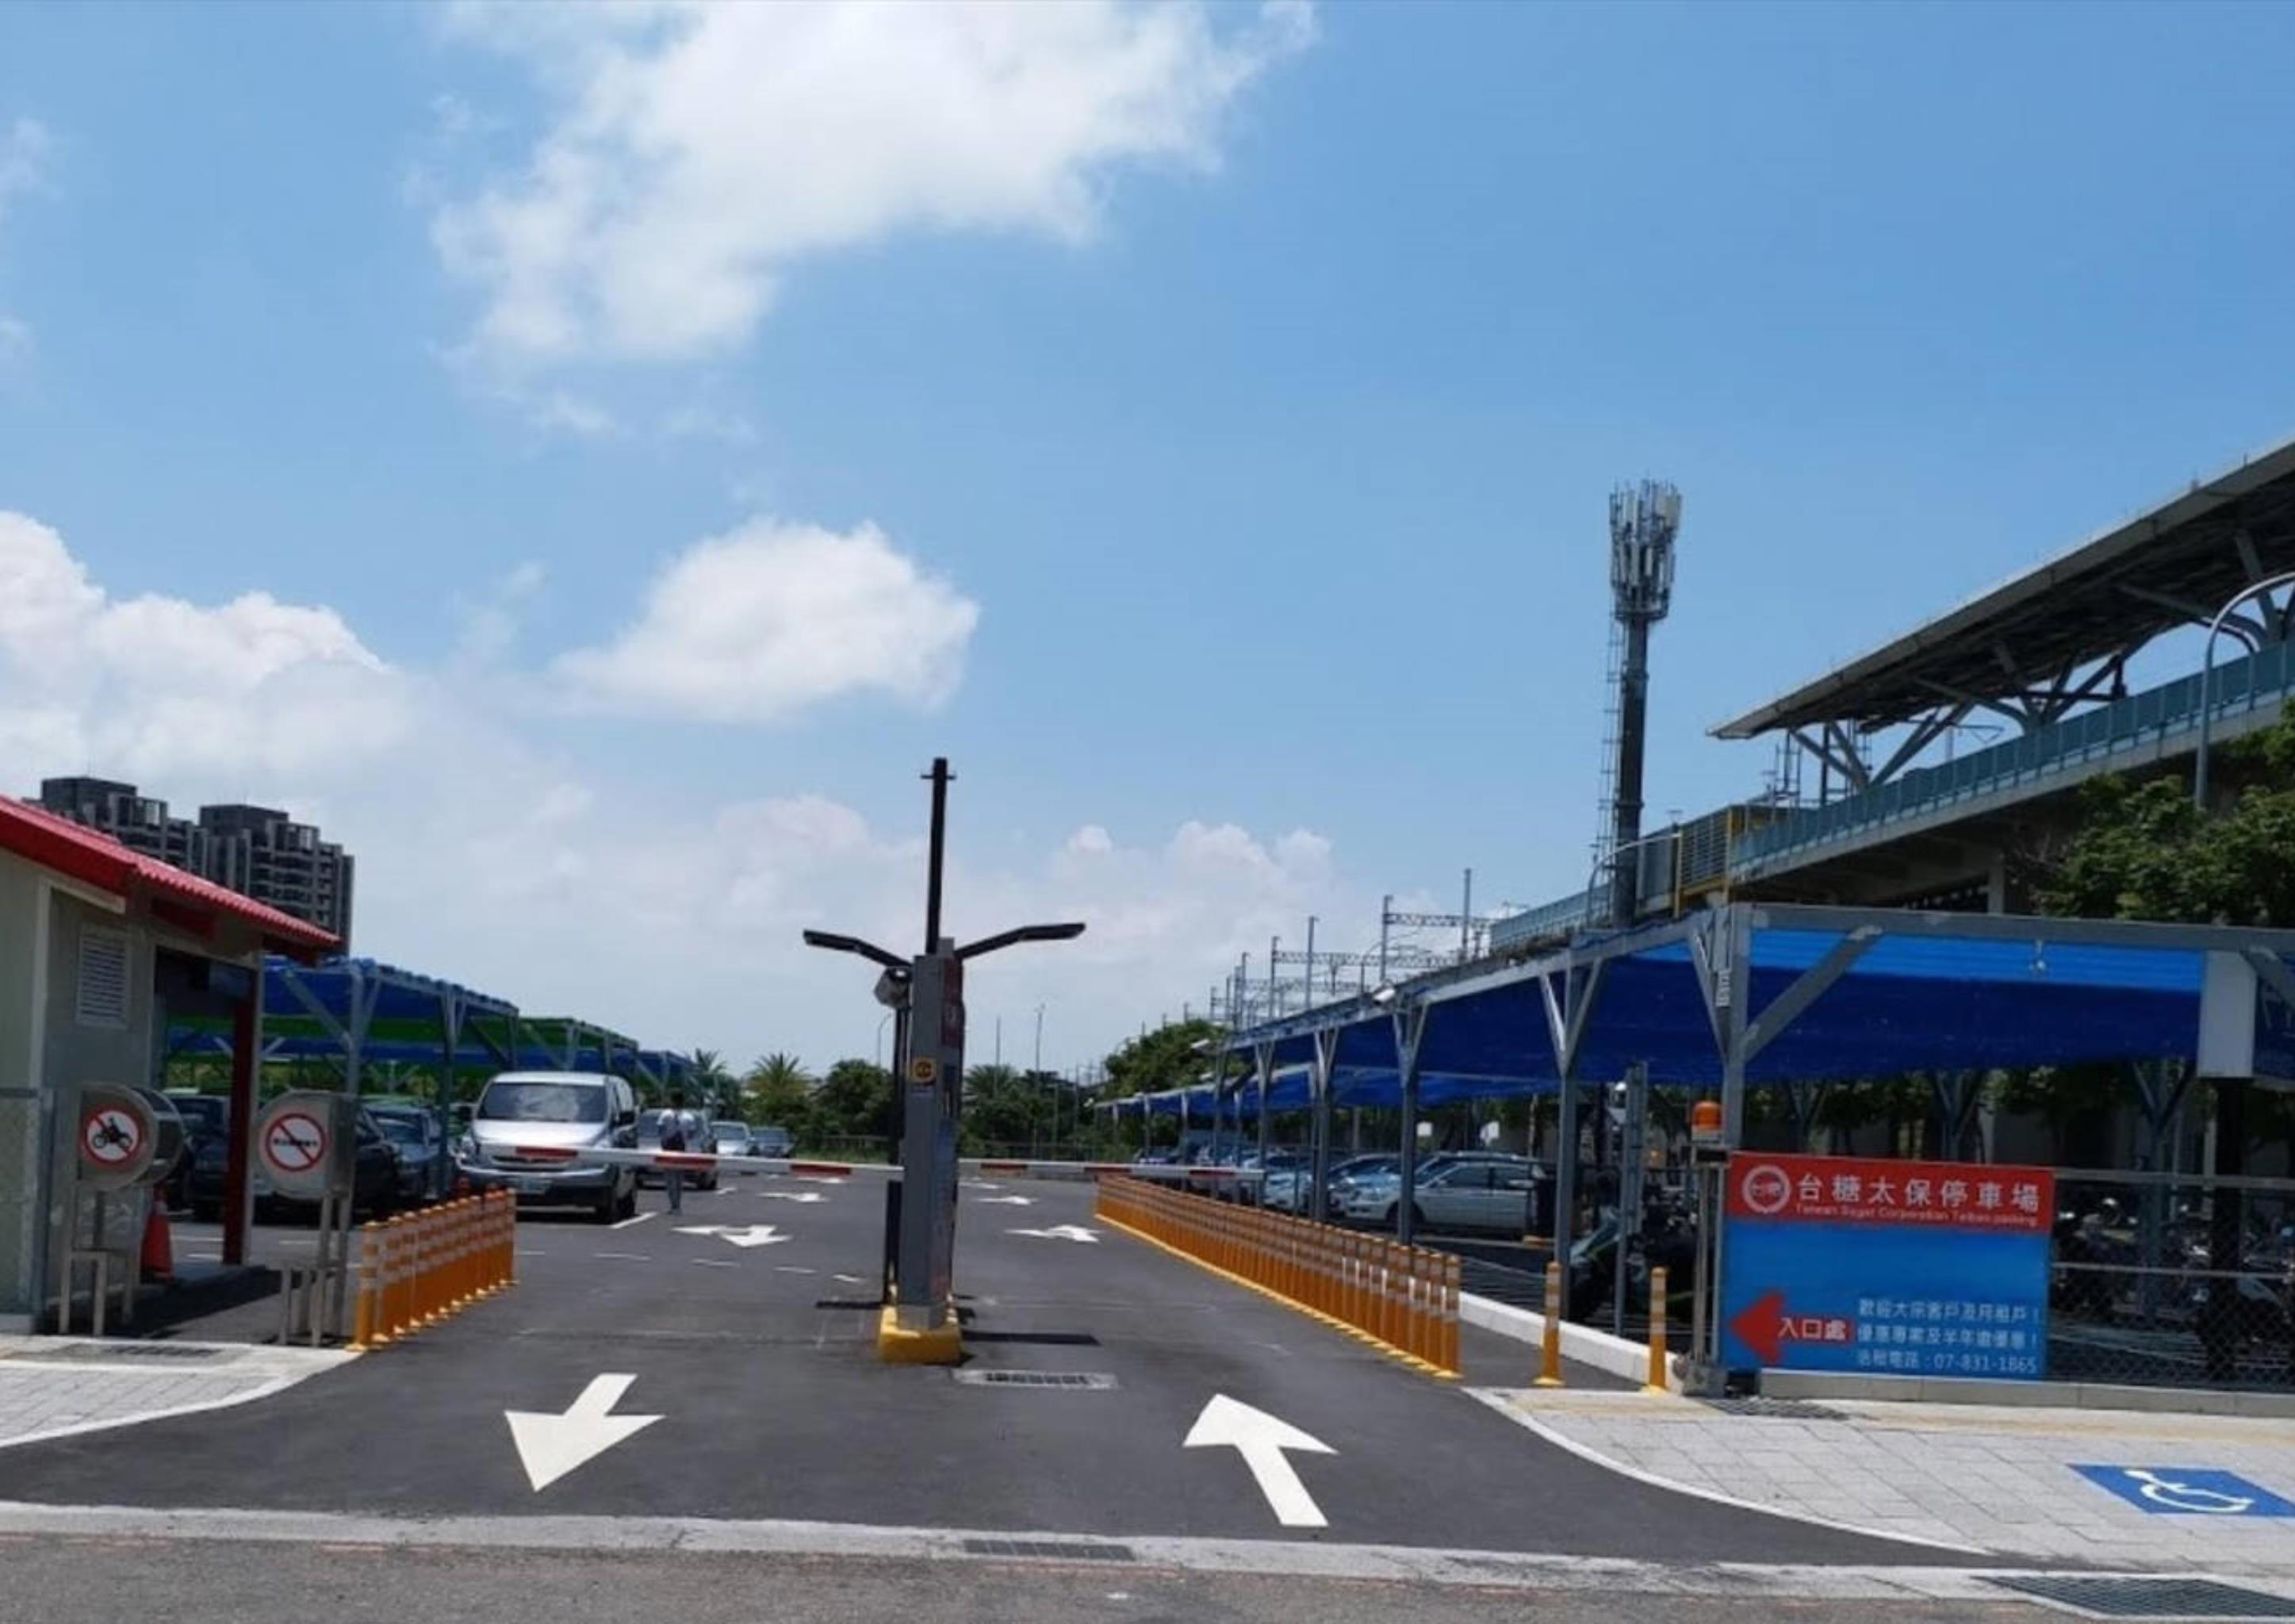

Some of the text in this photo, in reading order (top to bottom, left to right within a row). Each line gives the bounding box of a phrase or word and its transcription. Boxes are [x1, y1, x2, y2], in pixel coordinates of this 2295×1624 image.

[1797, 1172, 2039, 1213] 台糖太保停車場
[1776, 1316, 1846, 1340] 入口處
